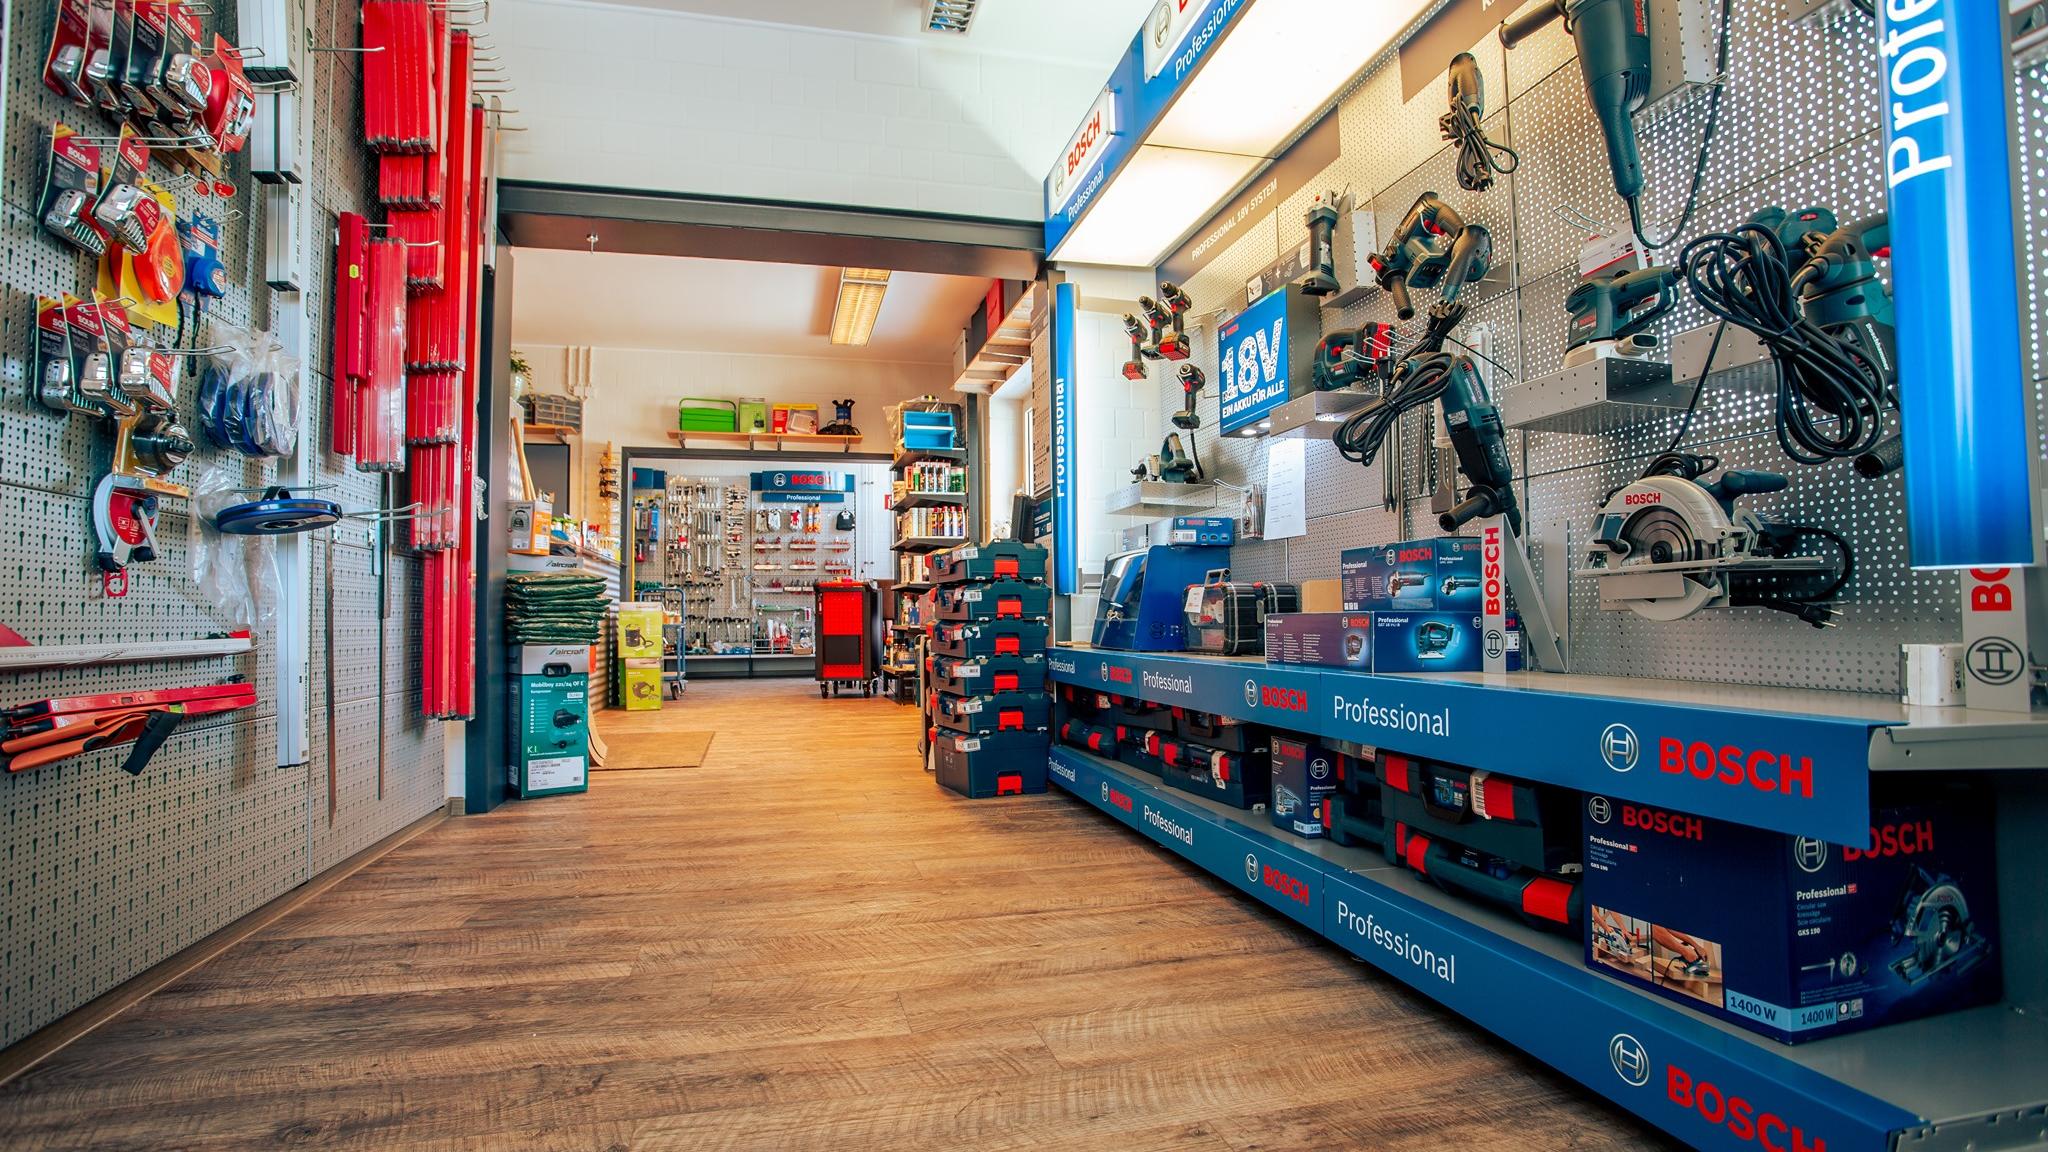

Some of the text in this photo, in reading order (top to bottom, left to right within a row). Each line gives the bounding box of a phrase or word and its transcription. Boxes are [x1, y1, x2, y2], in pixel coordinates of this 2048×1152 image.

[1067, 110, 1101, 177] BOSCH
[1068, 162, 1105, 222] Professional
[1191, 177, 1278, 261] PROFESSIONAL 18V SYSTEM
[1221, 317, 1283, 404] 18V
[1222, 379, 1285, 419] EIN AKKU FÜR ALLE
[786, 494, 821, 502] Professional
[1624, 493, 1661, 506] BOSCH
[1398, 547, 1433, 563] BOSCH
[1485, 527, 1501, 616] BOSCH
[1048, 657, 1076, 674] Professional
[1143, 670, 1192, 694] Professional
[1261, 685, 1308, 713] BOSCH
[1334, 695, 1450, 737] Professional
[1047, 756, 1076, 782] Professional
[1659, 736, 1814, 799] BOSCH
[1143, 804, 1194, 846] Professional
[1622, 805, 1703, 841] BOSCH
[1589, 835, 1629, 851] Professional
[1263, 863, 1310, 907] BOSCH
[1796, 885, 1847, 901] Professional
[1338, 900, 1456, 984] Professional
[1797, 927, 1821, 937] GKS 190
[1729, 995, 1777, 1022] 1400 W
[1800, 1007, 1834, 1025] 1400 W
[1666, 1063, 1827, 1152] BOSCH
